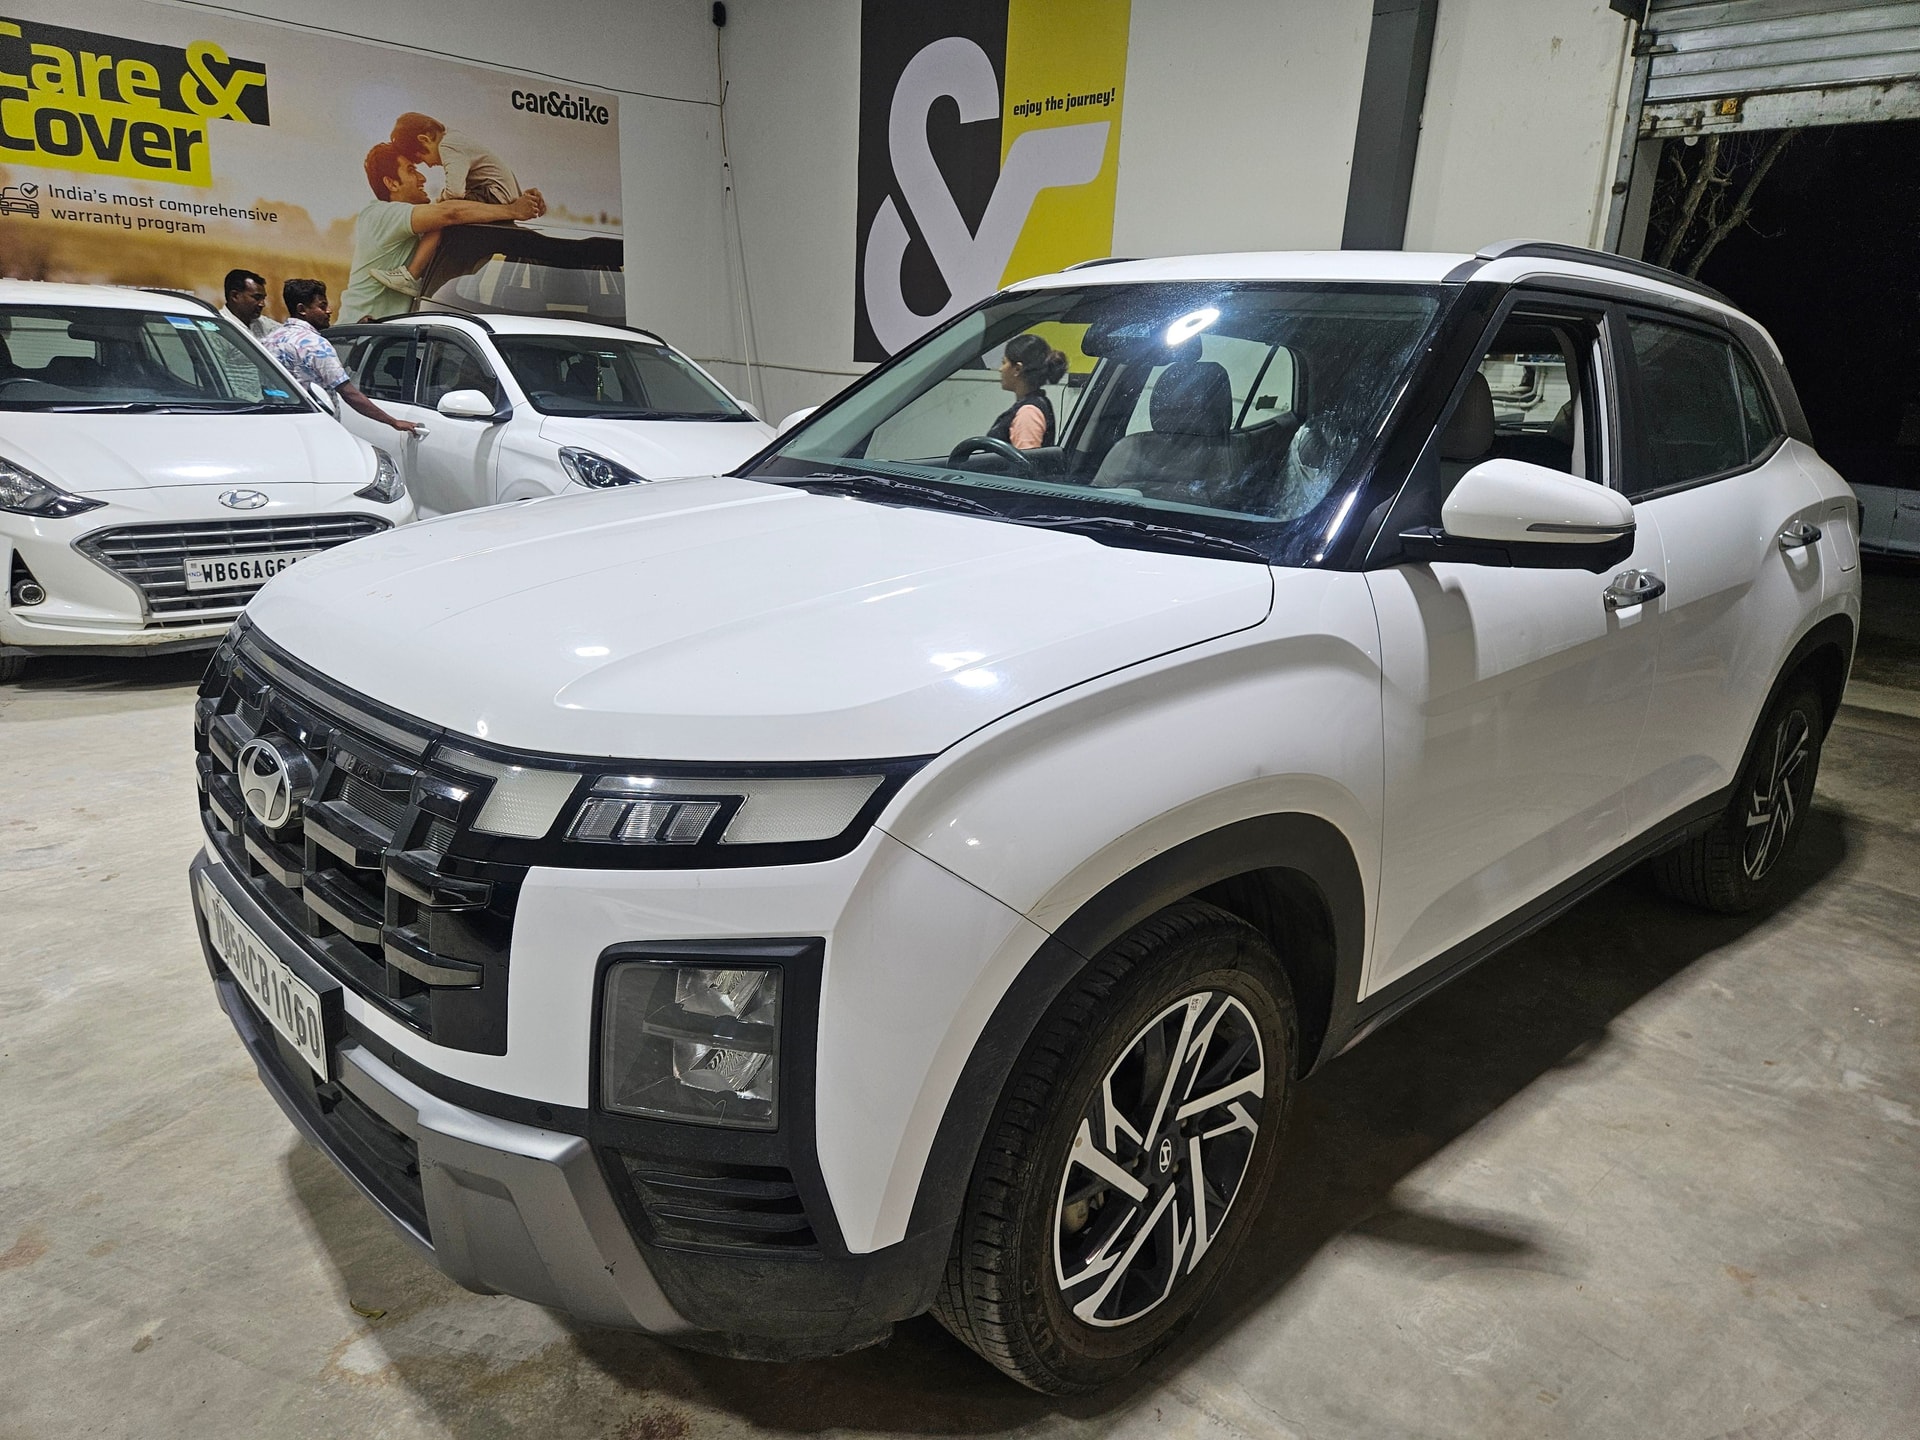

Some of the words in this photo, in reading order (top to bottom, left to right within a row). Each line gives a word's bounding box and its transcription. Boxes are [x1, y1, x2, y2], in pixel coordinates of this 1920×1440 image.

[0, 21, 161, 108] Care
[180, 39, 267, 124] &
[511, 90, 609, 125] car&bike
[1013, 99, 1043, 118] enjoy
[1045, 95, 1064, 112] the
[1065, 87, 1116, 112] journey!
[0, 85, 203, 173] Cover
[49, 184, 107, 204] India's
[112, 193, 155, 209] most
[159, 198, 279, 224] comprehensive
[51, 208, 132, 230] warranty
[137, 216, 206, 235] program
[201, 557, 307, 583] WB66AG6
